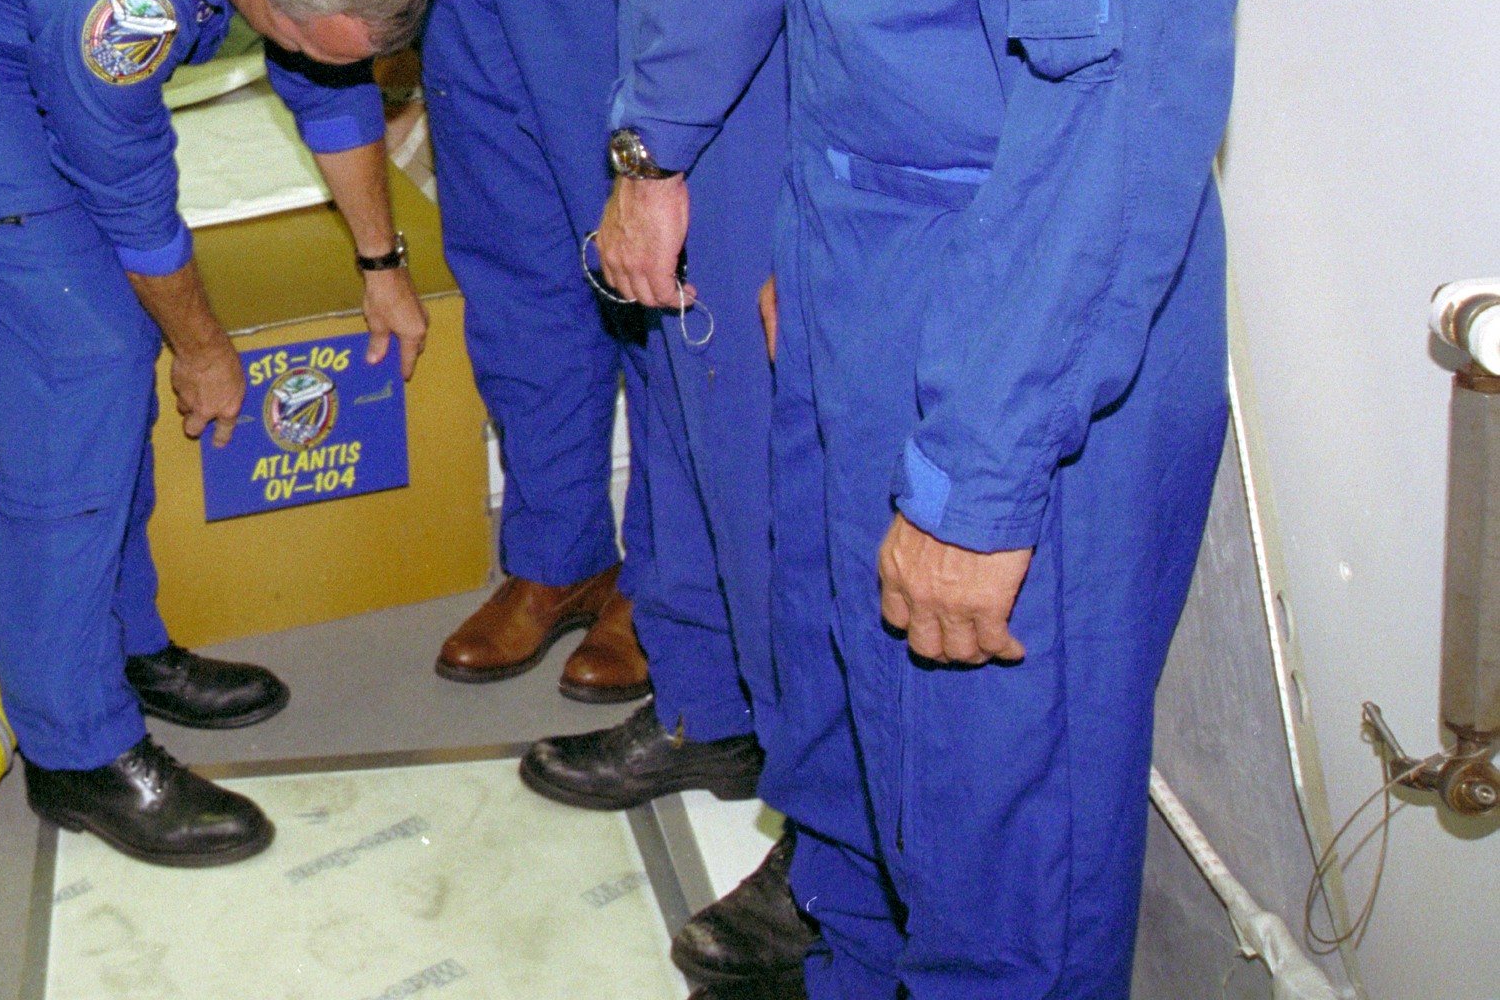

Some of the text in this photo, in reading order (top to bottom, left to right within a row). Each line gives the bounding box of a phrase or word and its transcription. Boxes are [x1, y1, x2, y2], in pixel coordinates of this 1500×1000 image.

[248, 345, 352, 386] STS-106
[250, 440, 363, 482] ATLANTIS
[264, 466, 357, 502] OV-104
